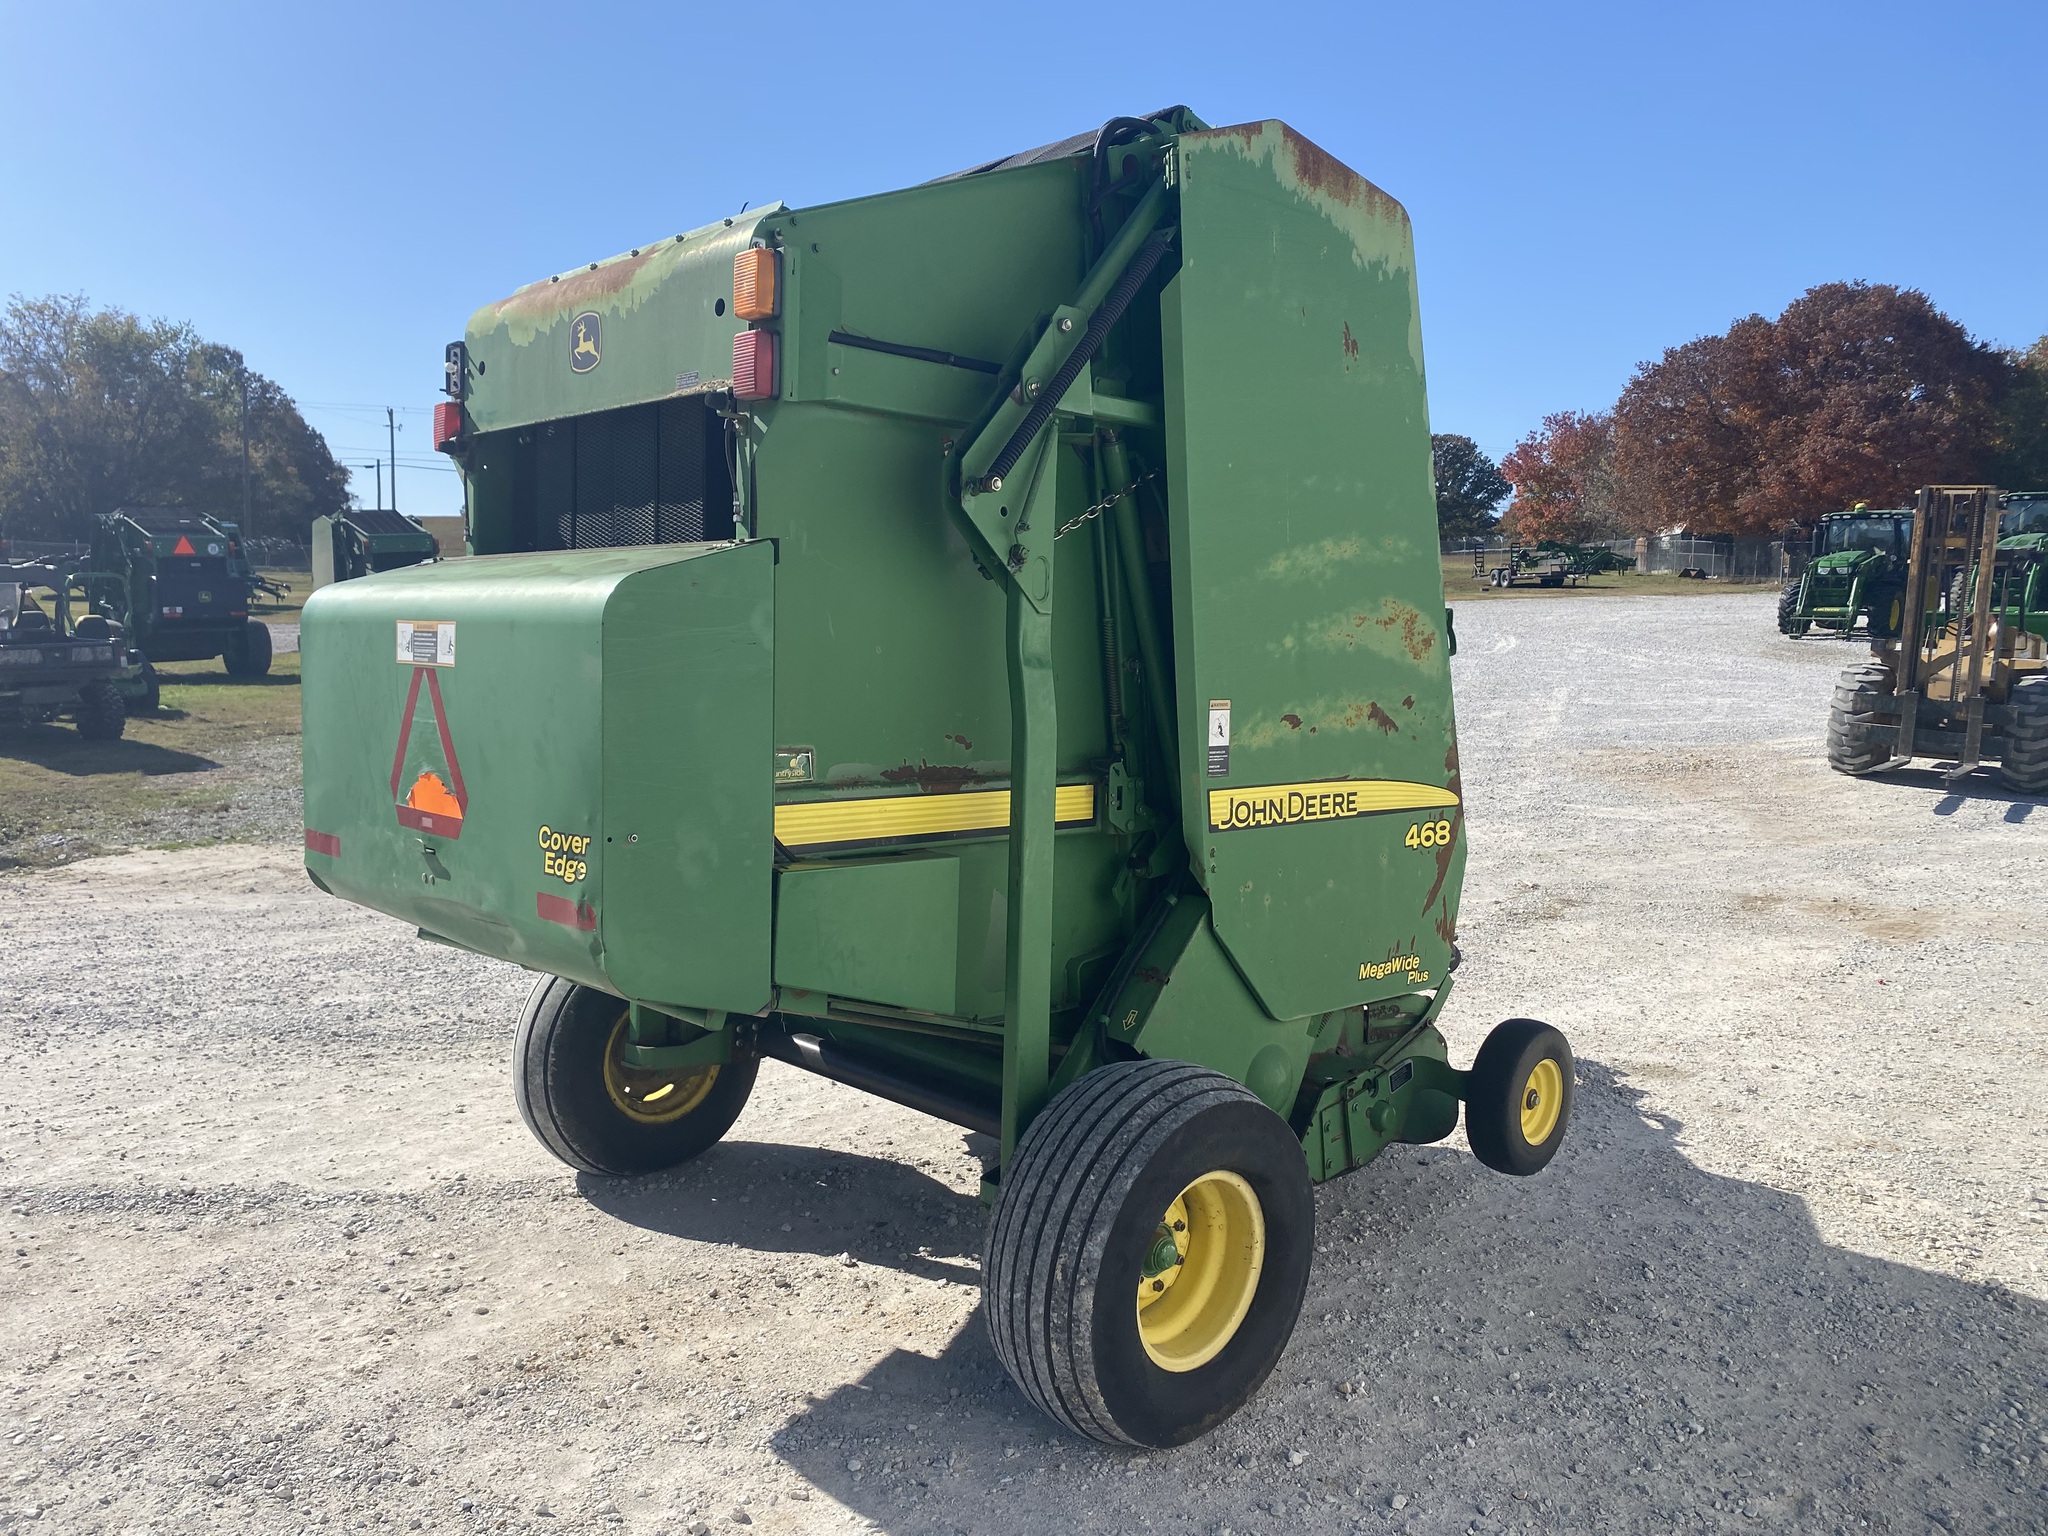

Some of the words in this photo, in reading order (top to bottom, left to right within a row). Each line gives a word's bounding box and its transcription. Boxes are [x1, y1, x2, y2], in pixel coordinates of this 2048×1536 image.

[1219, 797, 1284, 826] JOHN
[1287, 791, 1358, 819] DEERE
[539, 825, 591, 855] Cover
[1405, 820, 1451, 849] 468
[544, 851, 587, 883] Edge
[1359, 954, 1420, 980] MegaWide
[1407, 969, 1430, 985] Plus
